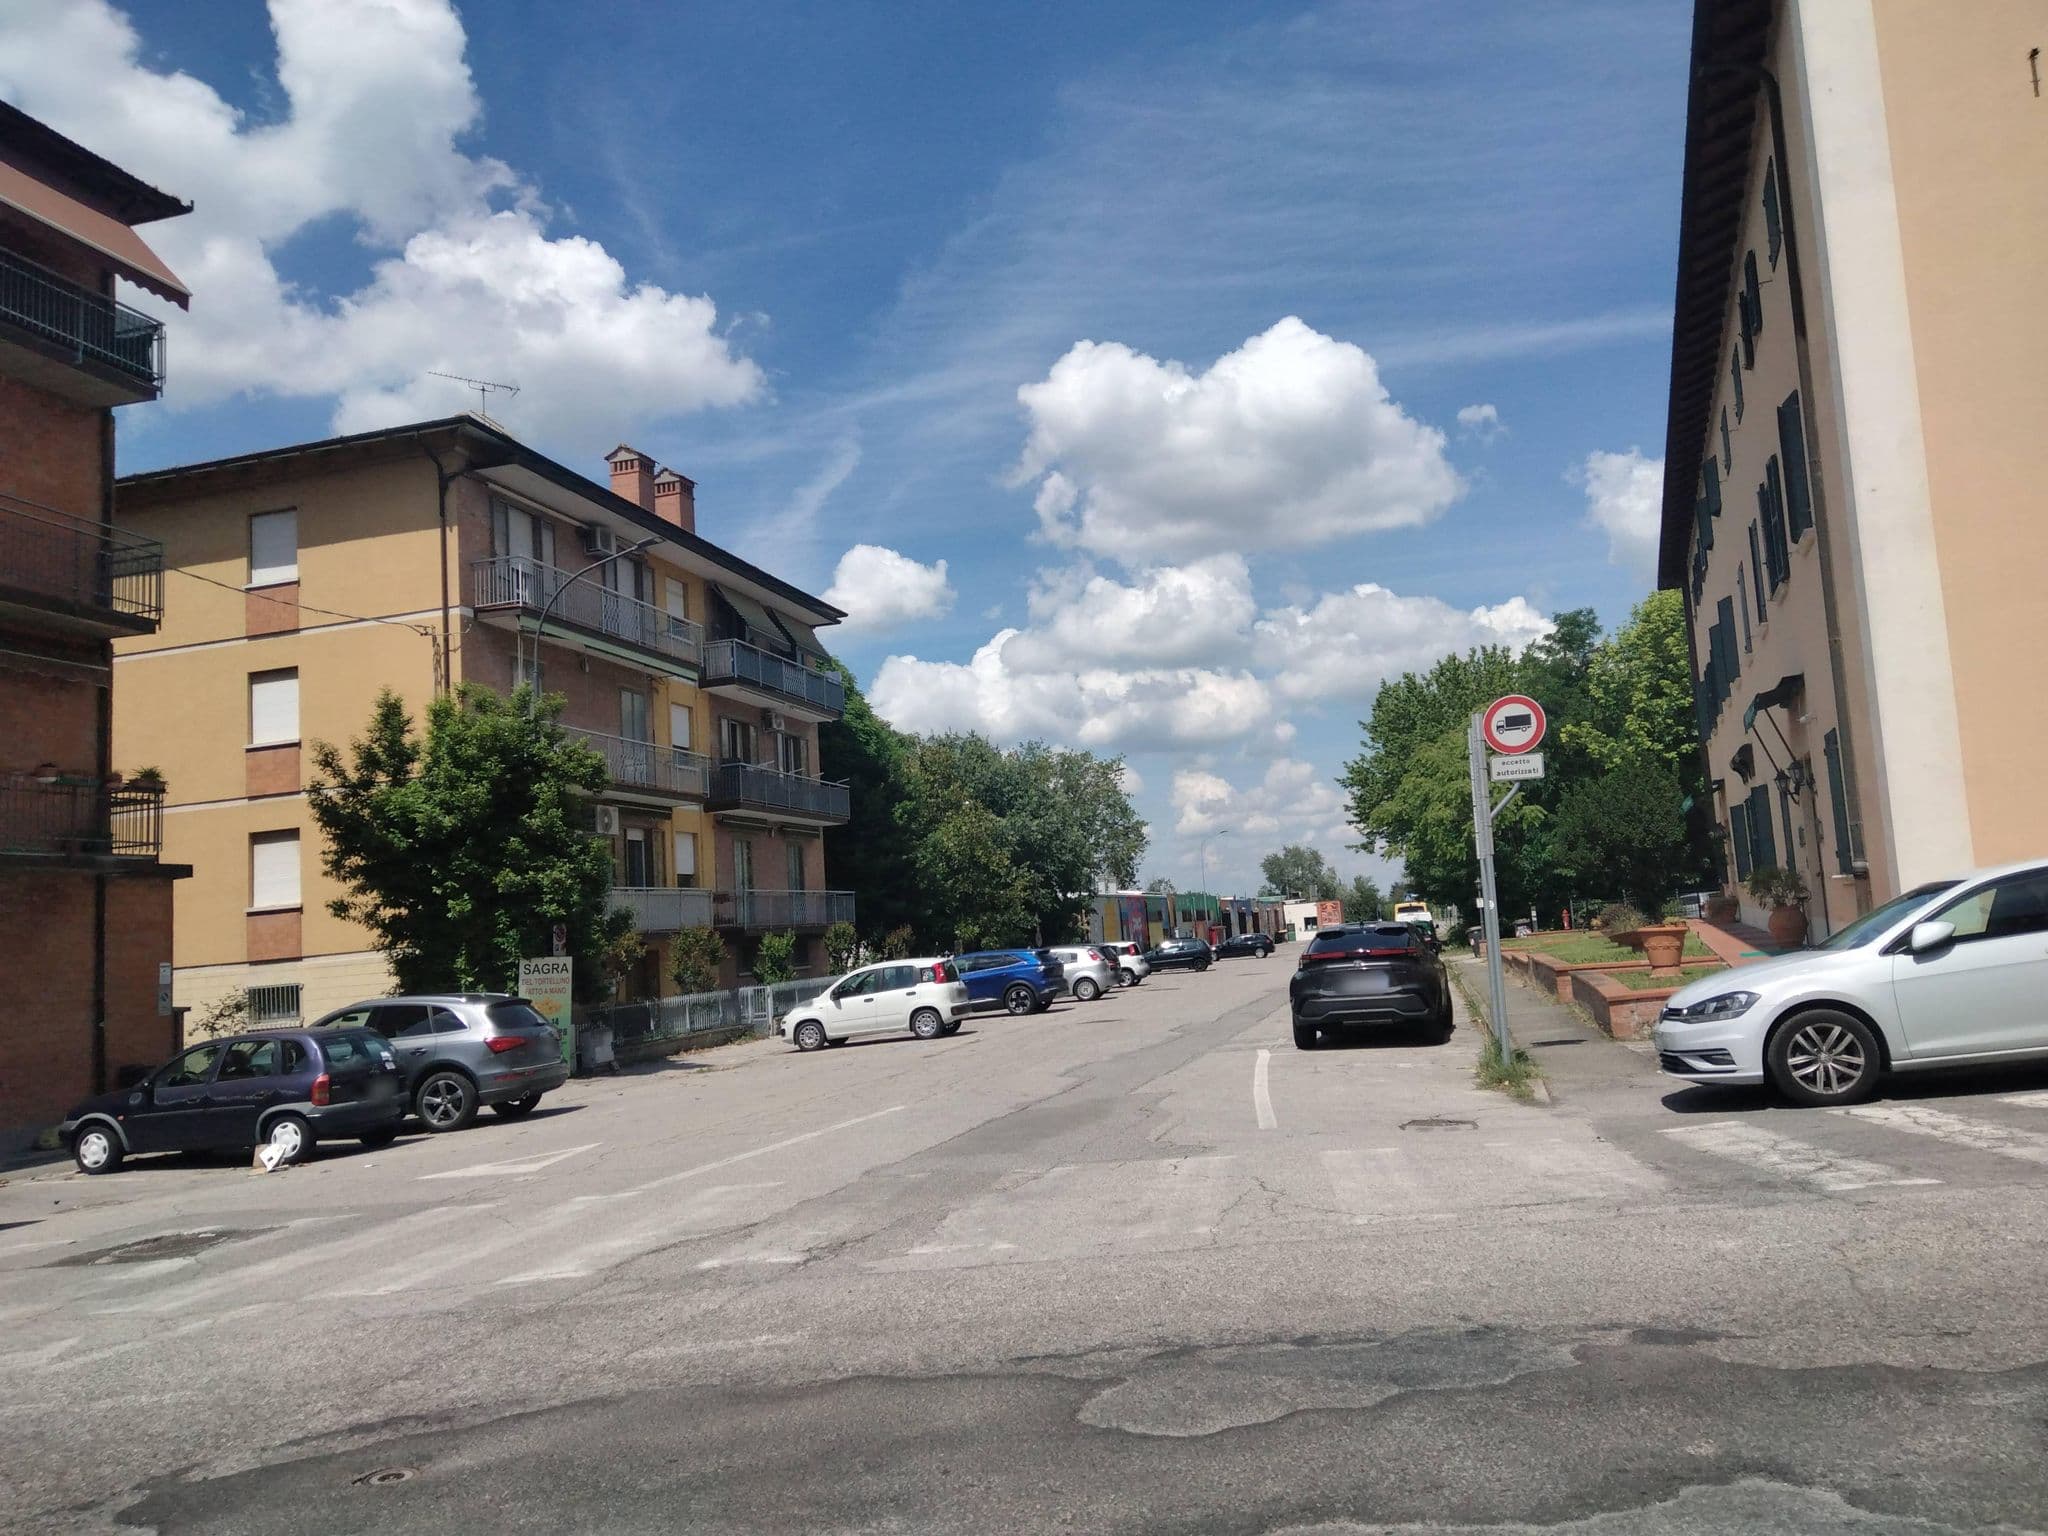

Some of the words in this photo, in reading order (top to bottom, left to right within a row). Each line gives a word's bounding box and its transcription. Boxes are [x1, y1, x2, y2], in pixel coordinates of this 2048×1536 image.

[1496, 767, 1539, 777] autorizzati
[523, 963, 569, 975] SAGRA
[534, 977, 570, 985] TORTELLINO
